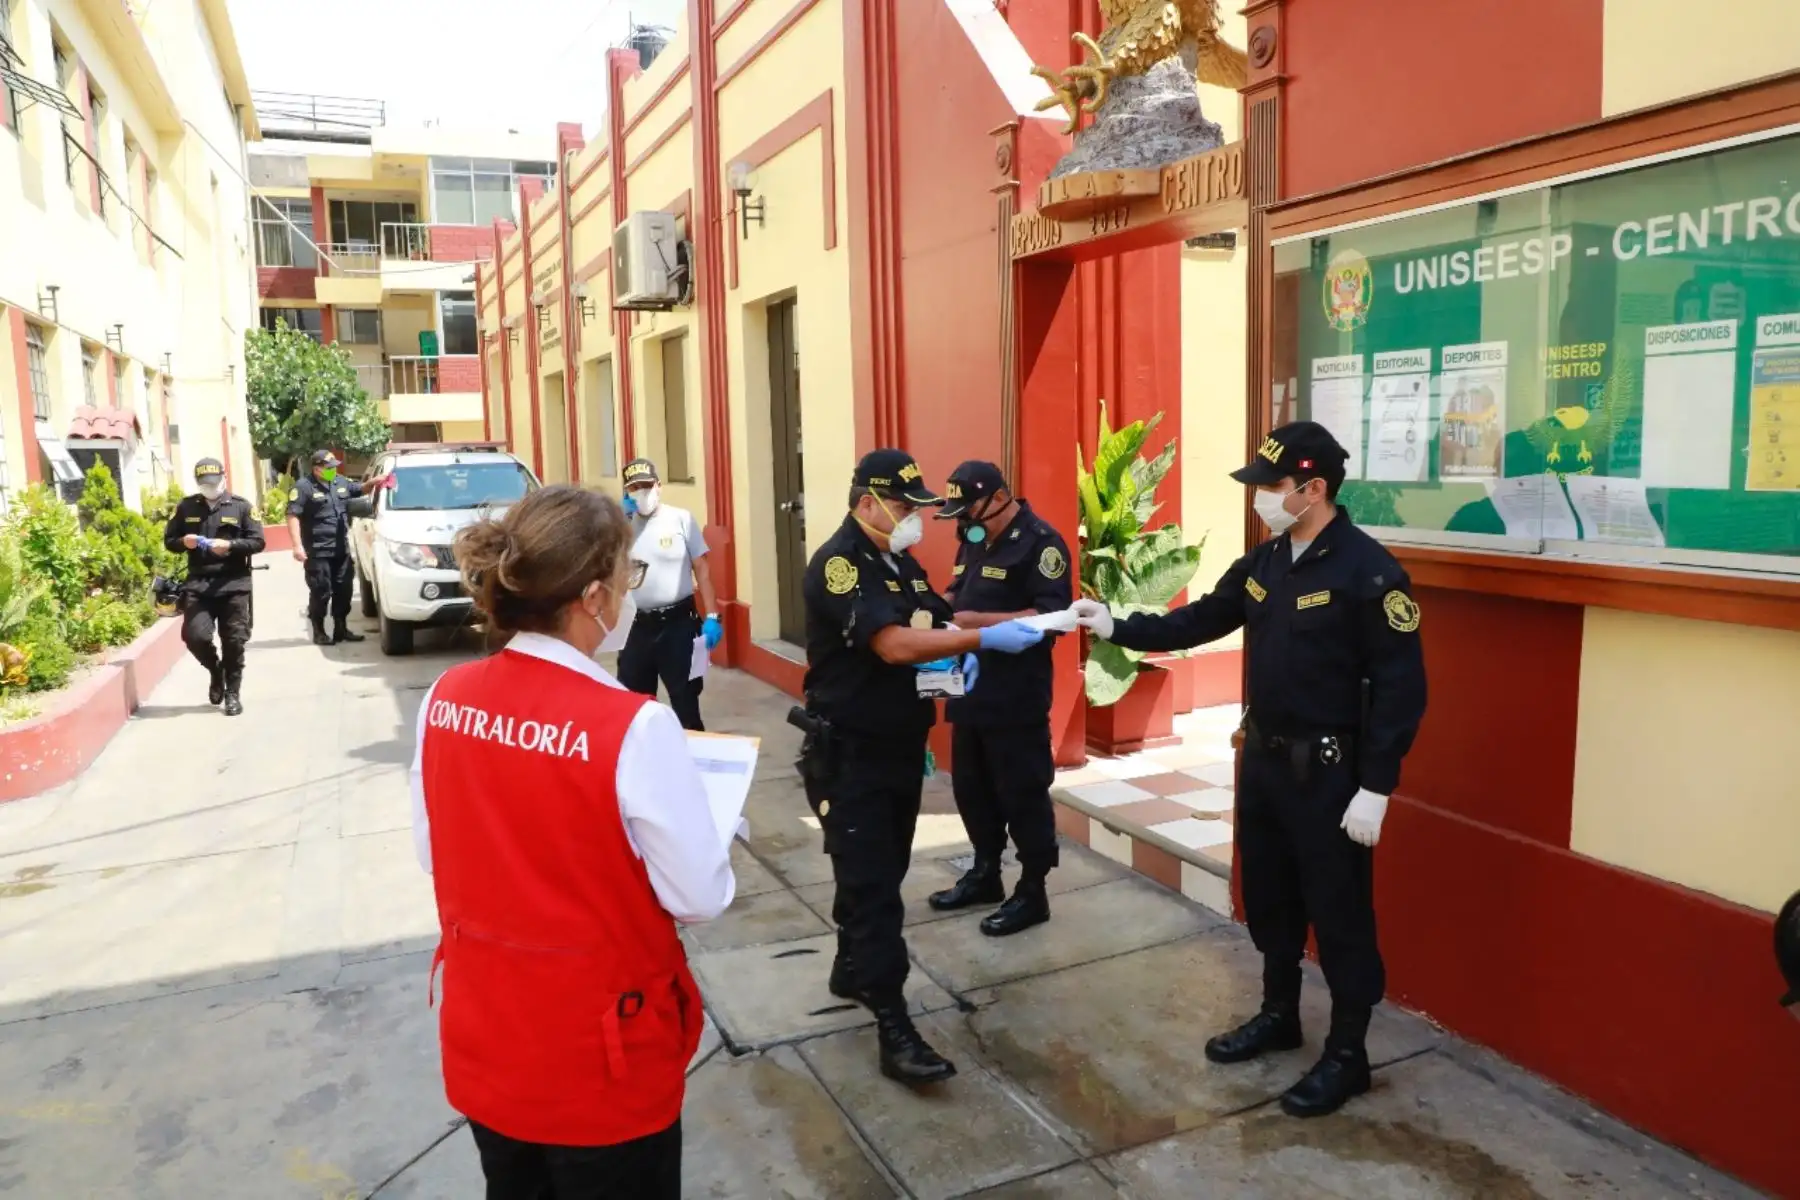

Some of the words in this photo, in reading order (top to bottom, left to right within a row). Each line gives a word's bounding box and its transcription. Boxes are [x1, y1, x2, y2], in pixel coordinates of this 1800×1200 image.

[1162, 148, 1243, 214] CENTRO
[1394, 234, 1572, 294] UNISEESP
[1647, 326, 1730, 345] DISPOSICIONES
[1444, 349, 1502, 364] DEPORTES
[1540, 343, 1607, 360] UNISEESP
[1317, 360, 1356, 374] NOTICIAS
[1376, 356, 1425, 370] EDITORIAL
[1543, 361, 1601, 379] CENTRO
[429, 699, 590, 762] CONTRALORÍA
